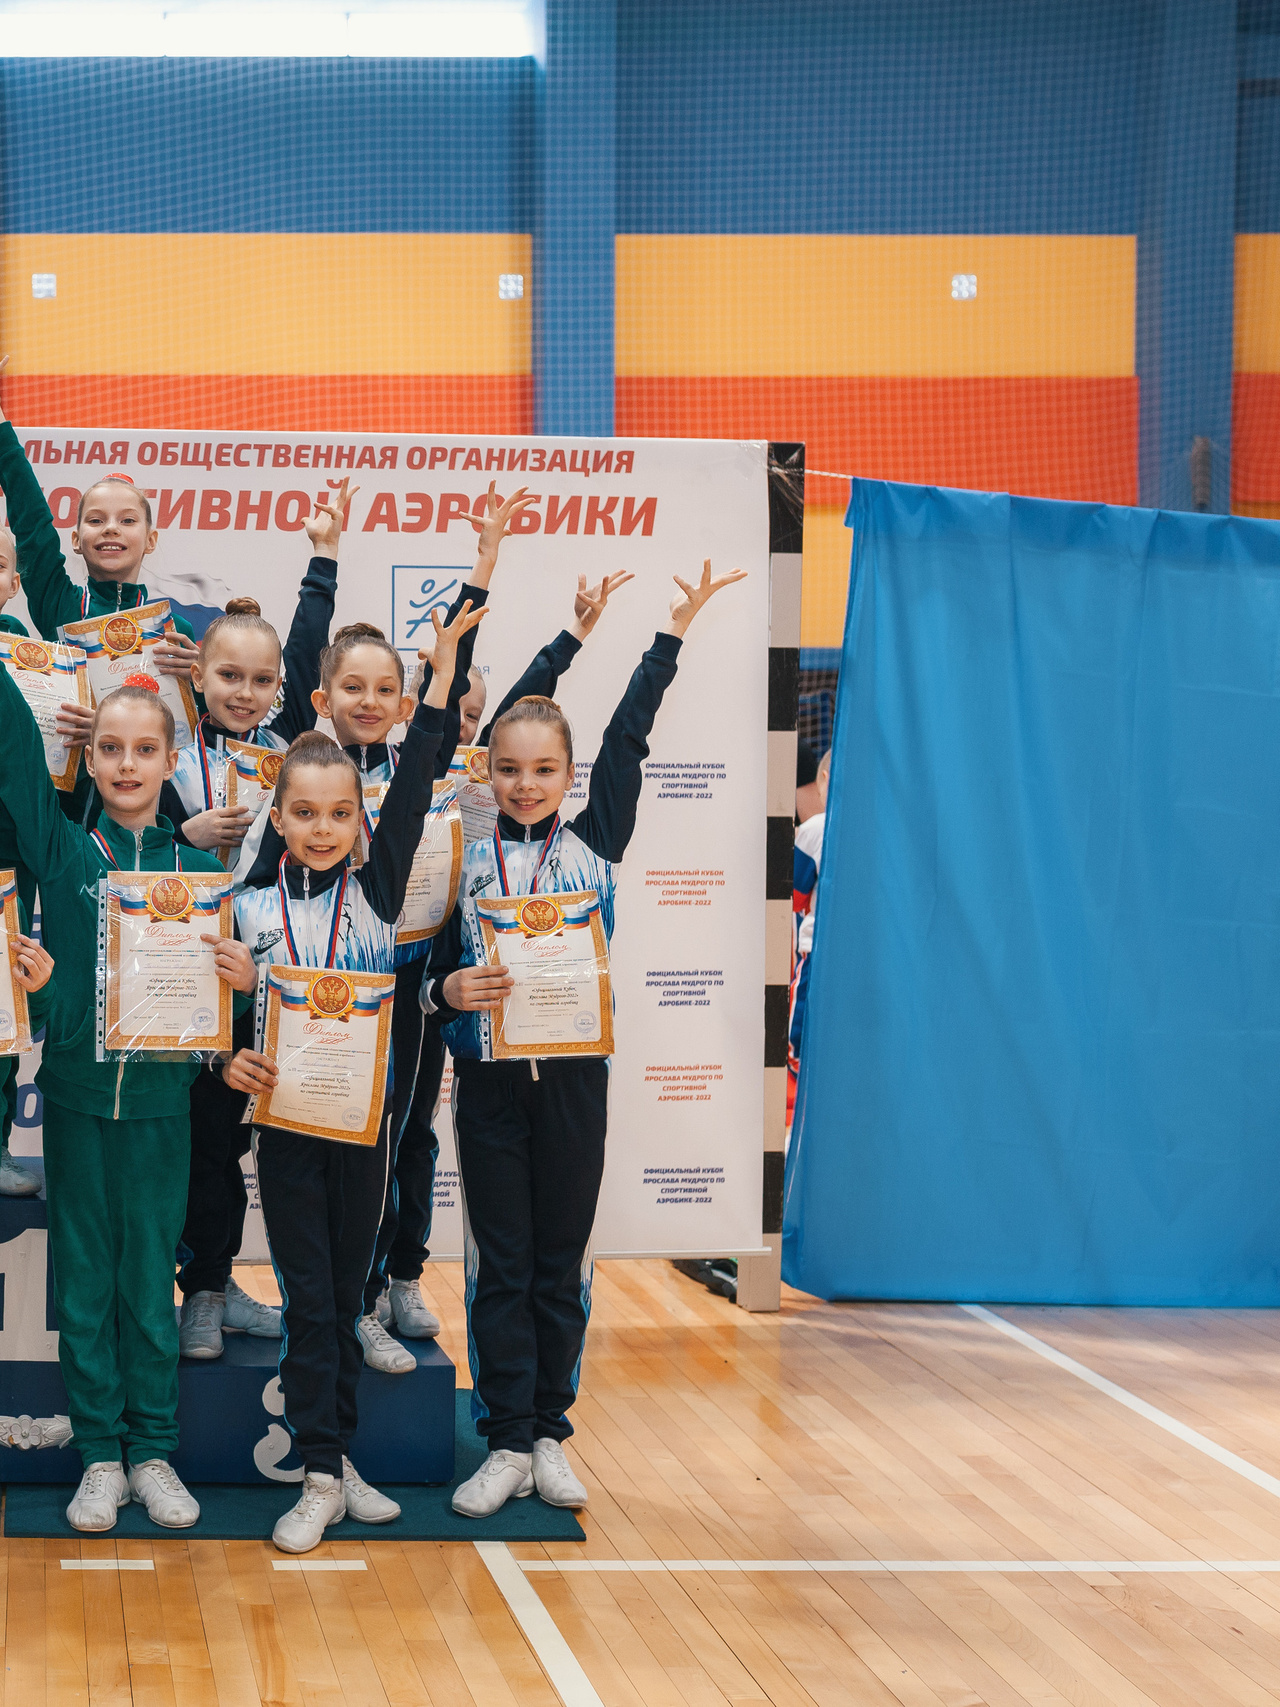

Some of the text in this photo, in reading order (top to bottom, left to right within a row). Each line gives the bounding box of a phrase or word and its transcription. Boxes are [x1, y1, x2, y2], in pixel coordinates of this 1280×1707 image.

[137, 441, 399, 471] ОБЩЕСТВЕННАЯ
[406, 446, 635, 478] ОРГАНИЗАЦИЯ
[646, 969, 698, 977] ОФИЦИАЛЬНЫЙ
[646, 1064, 700, 1072] ОФИЦИАЛЬНЫЙ
